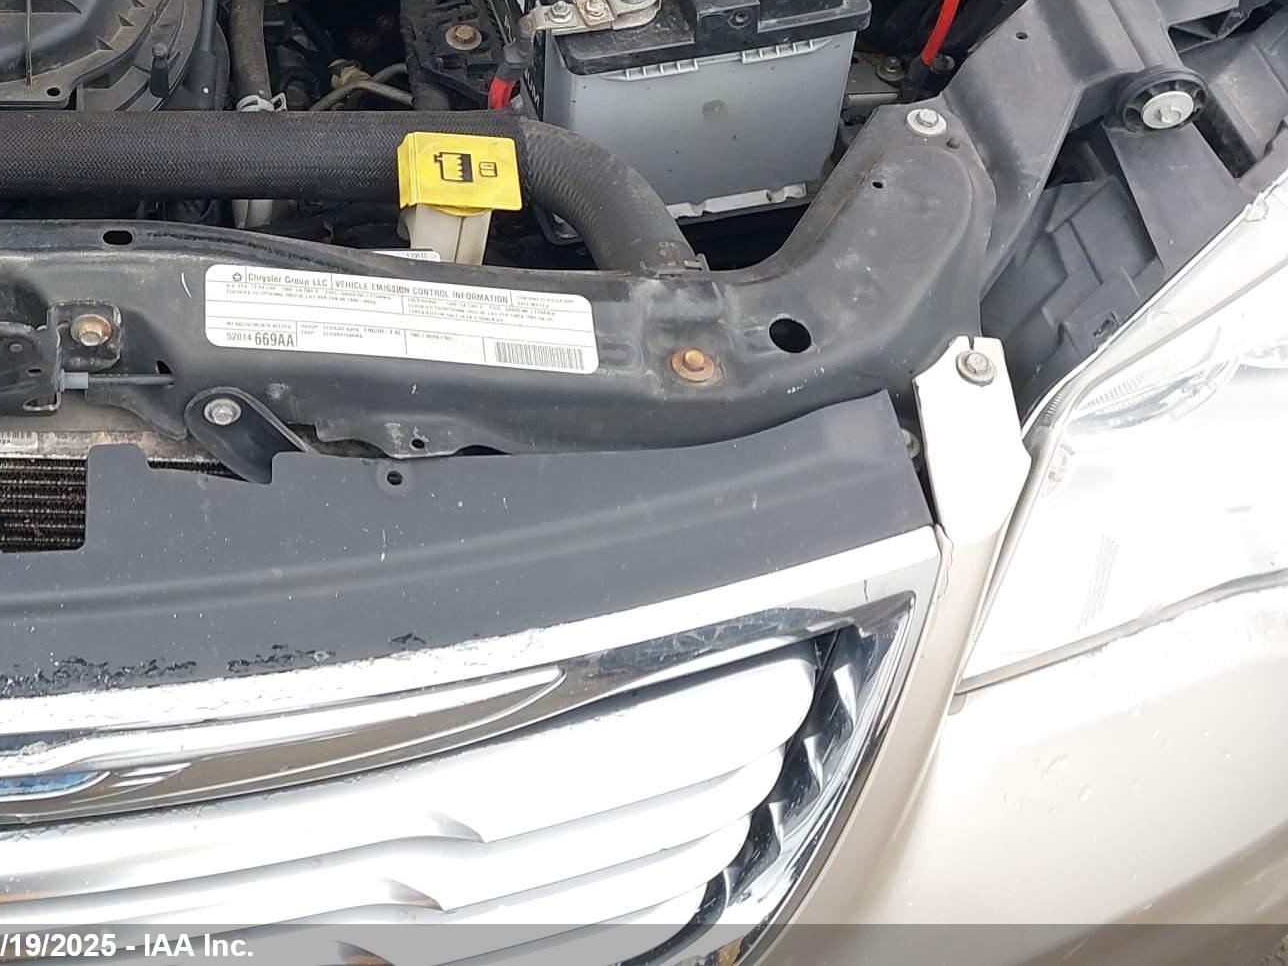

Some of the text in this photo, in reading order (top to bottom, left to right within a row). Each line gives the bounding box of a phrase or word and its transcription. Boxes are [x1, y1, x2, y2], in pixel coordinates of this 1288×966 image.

[248, 273, 282, 284] Chrysler
[285, 275, 310, 286] Group
[312, 278, 328, 287] LLC
[335, 280, 368, 290] VEHICLE
[371, 285, 410, 296] EMISSION
[412, 287, 449, 298] CONTROL
[452, 291, 508, 304] INFORMATION
